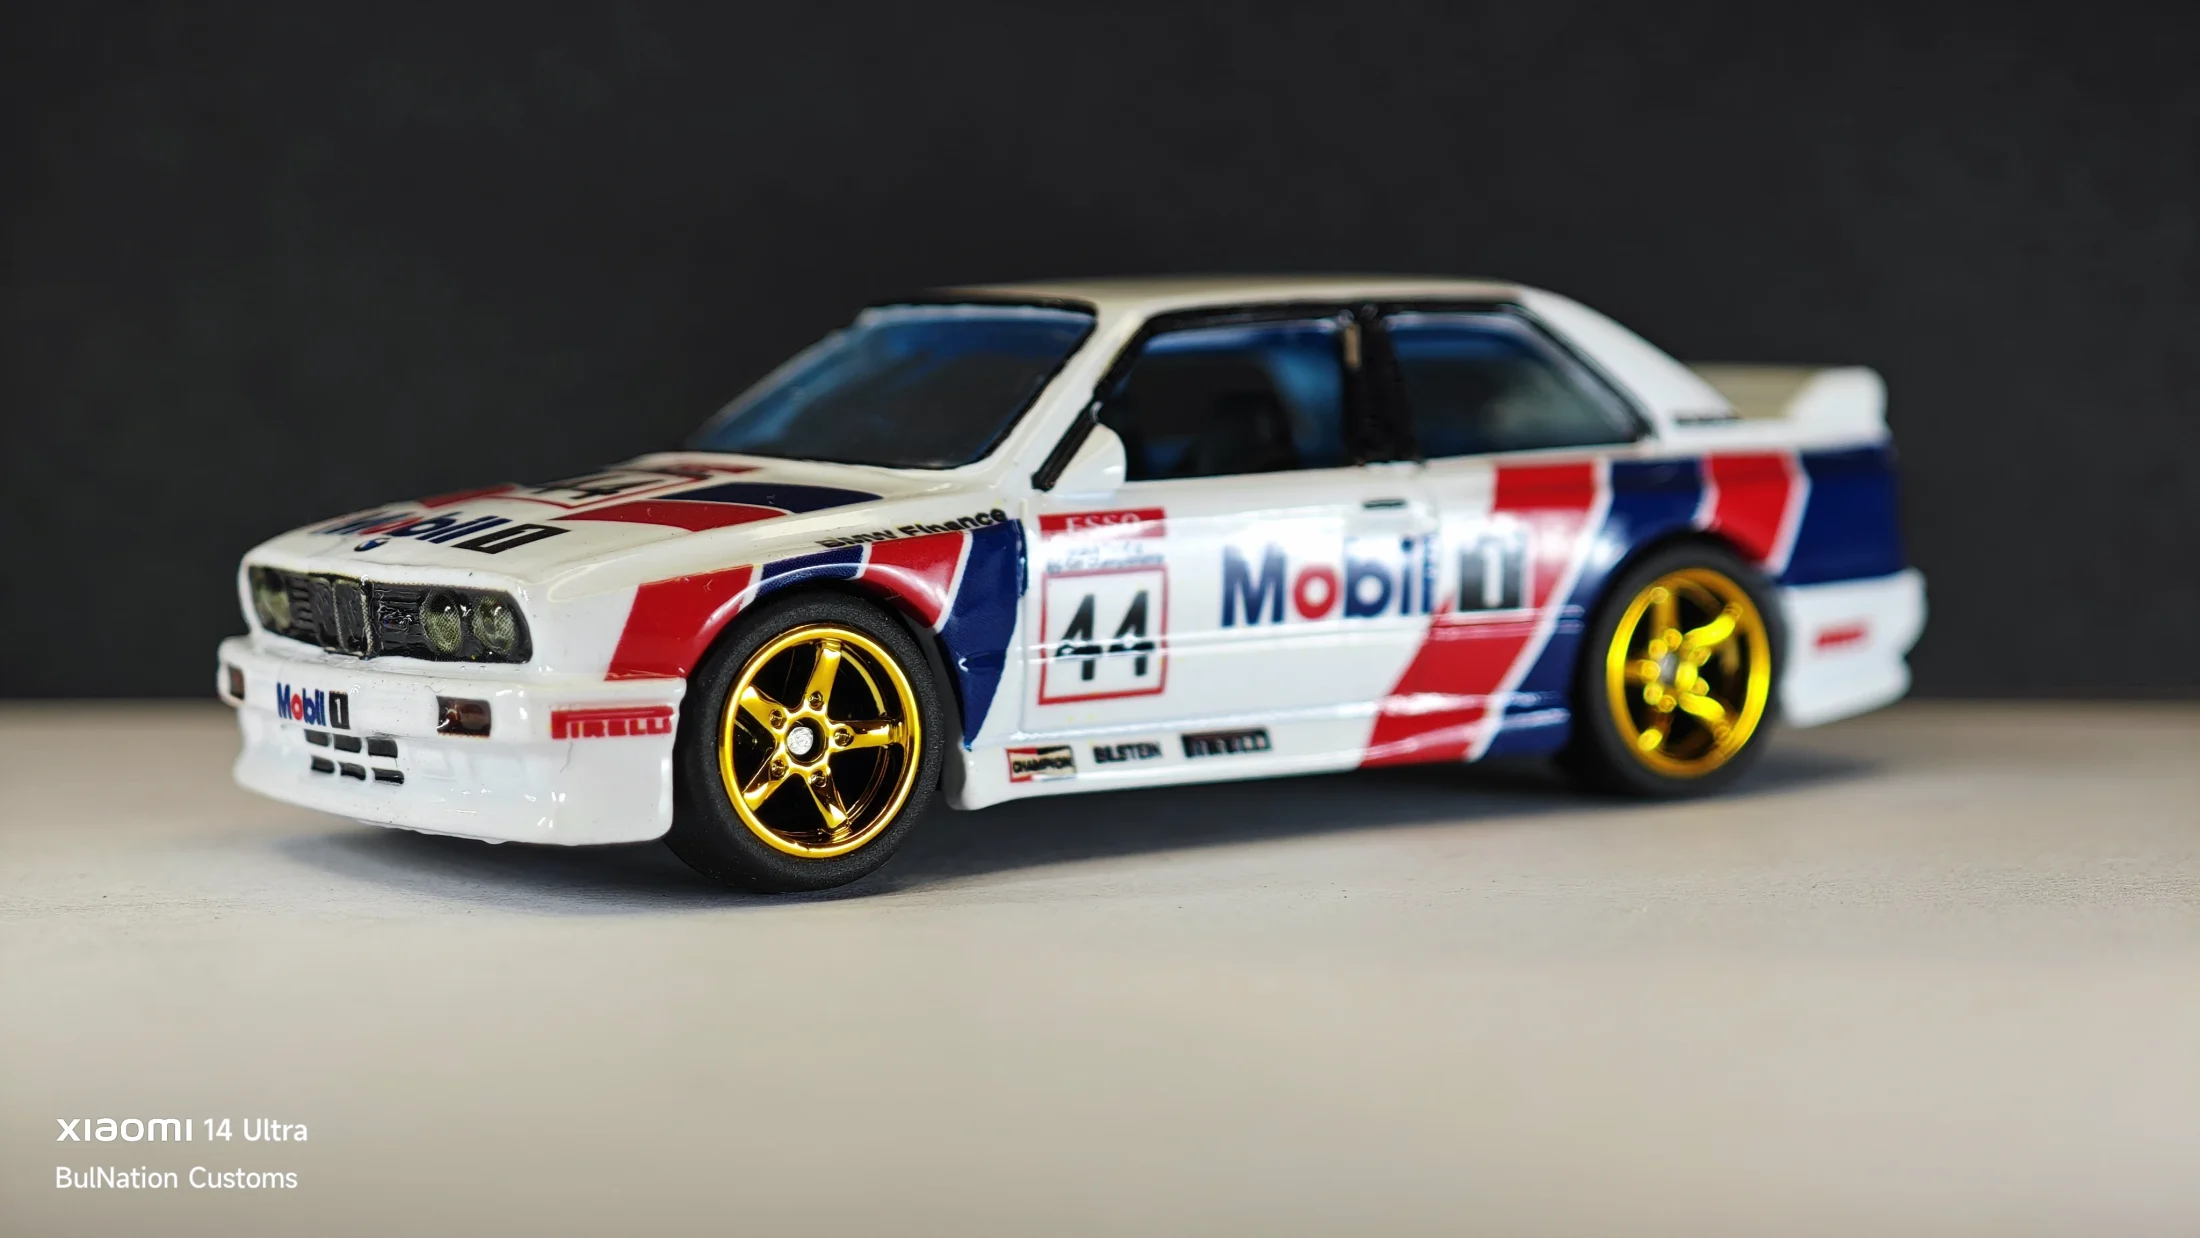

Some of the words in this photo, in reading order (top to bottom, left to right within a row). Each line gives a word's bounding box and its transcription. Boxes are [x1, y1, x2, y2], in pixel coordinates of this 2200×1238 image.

[815, 528, 898, 549] BMW
[897, 508, 1008, 537] Finance
[1221, 533, 1435, 628] Mobil
[1056, 590, 1155, 681] 44
[276, 681, 327, 727] Mobil
[551, 705, 674, 740] PIRELLI
